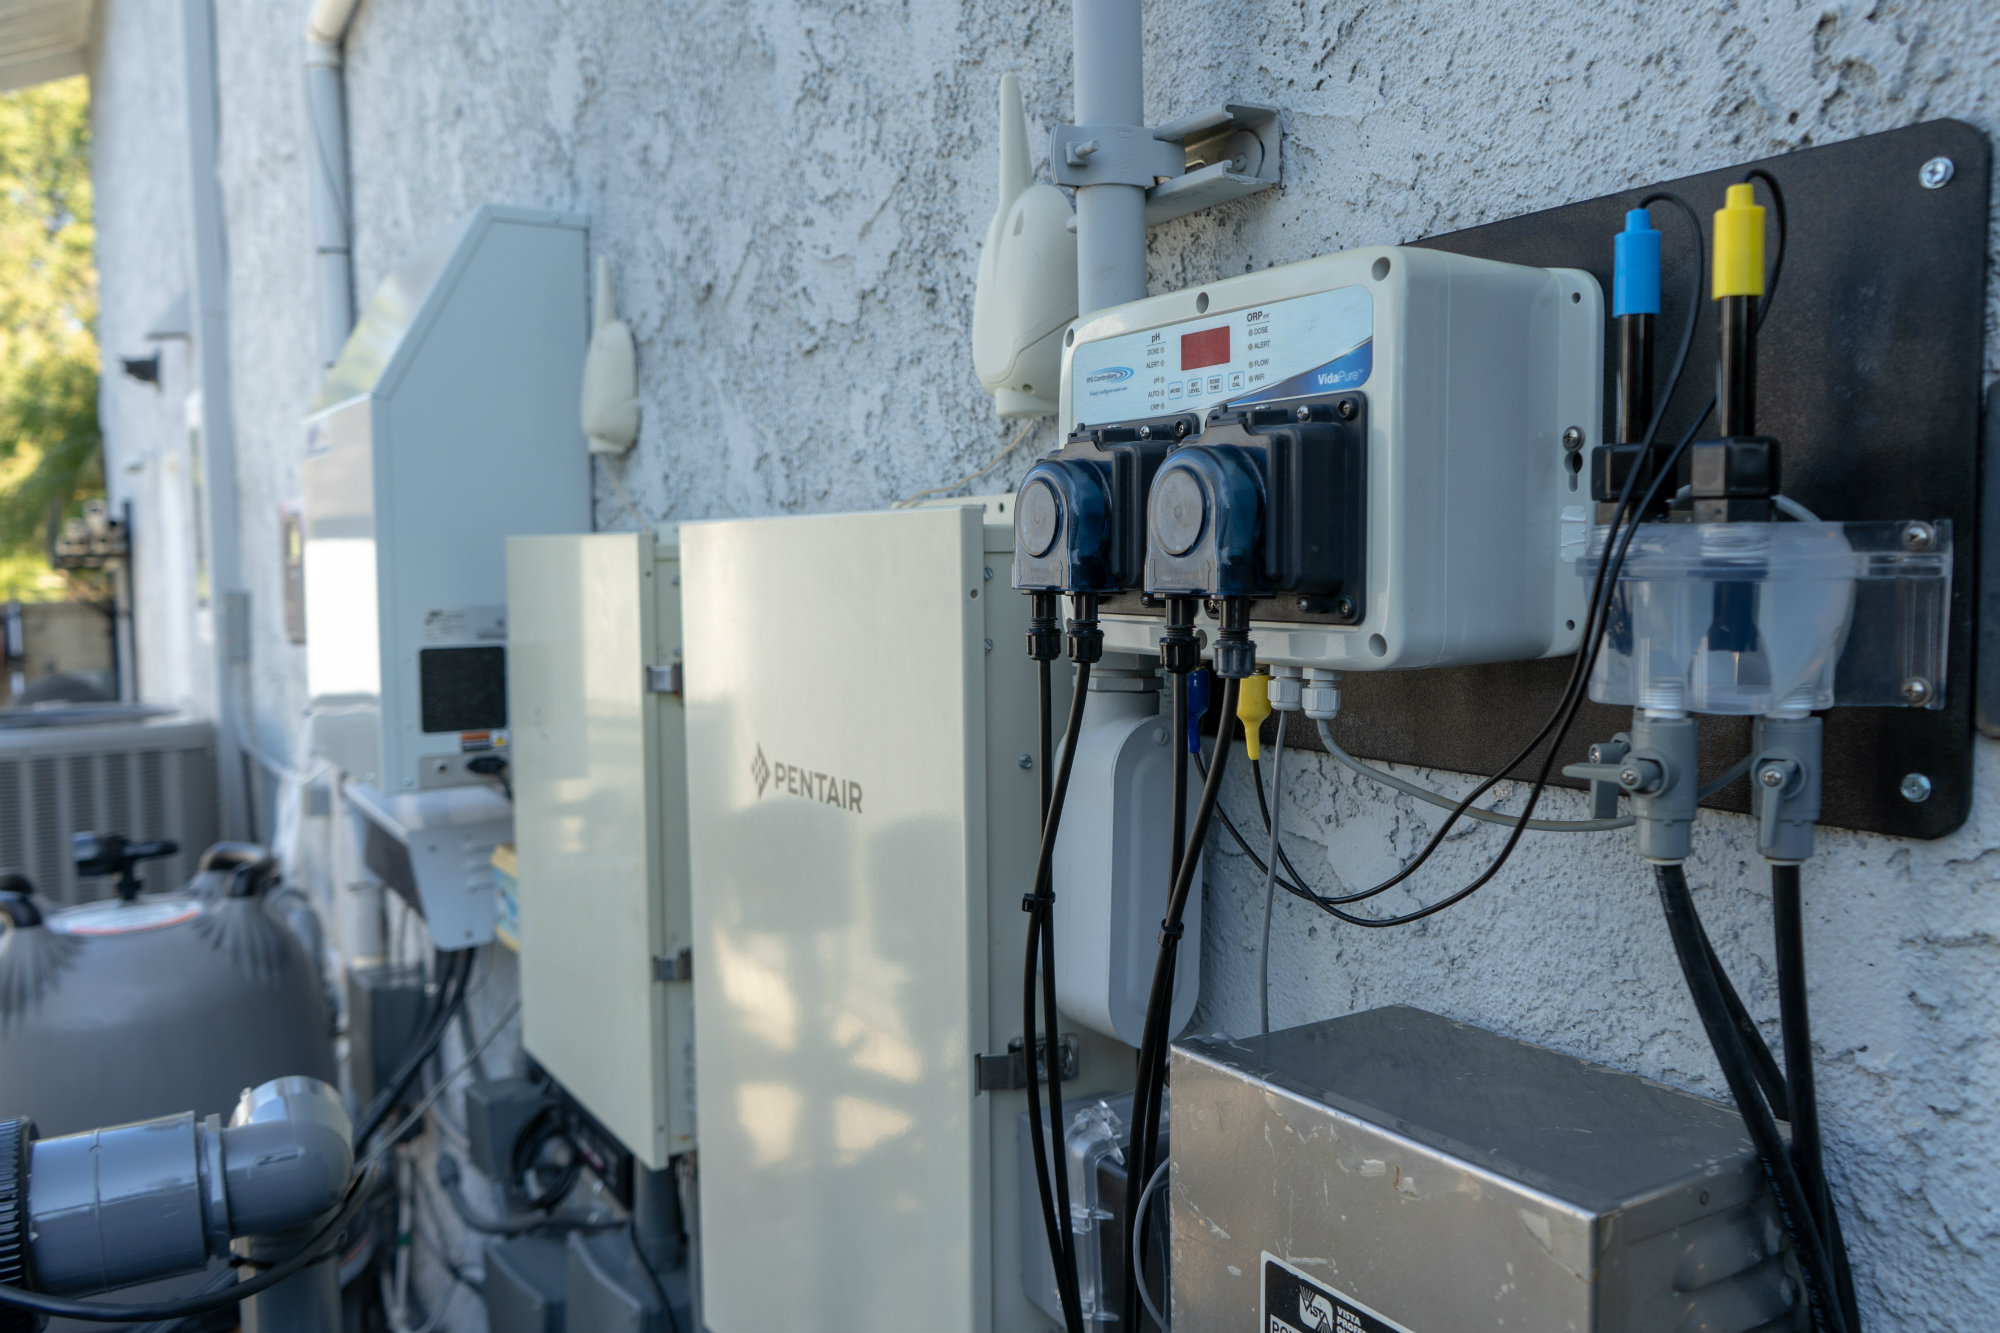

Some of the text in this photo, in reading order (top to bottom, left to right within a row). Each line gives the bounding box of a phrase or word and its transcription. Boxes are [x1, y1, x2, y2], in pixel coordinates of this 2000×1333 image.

[1246, 310, 1262, 322] ORP
[1254, 326, 1268, 335] DOSE
[1151, 333, 1160, 344] pH
[1254, 340, 1270, 349] ALERT
[1146, 360, 1160, 368] ALERT
[1254, 358, 1270, 367] FLOW
[774, 762, 862, 814] PENTAIR
[1336, 1306, 1362, 1327] VISTA
[1336, 1316, 1368, 1333] PROFE
